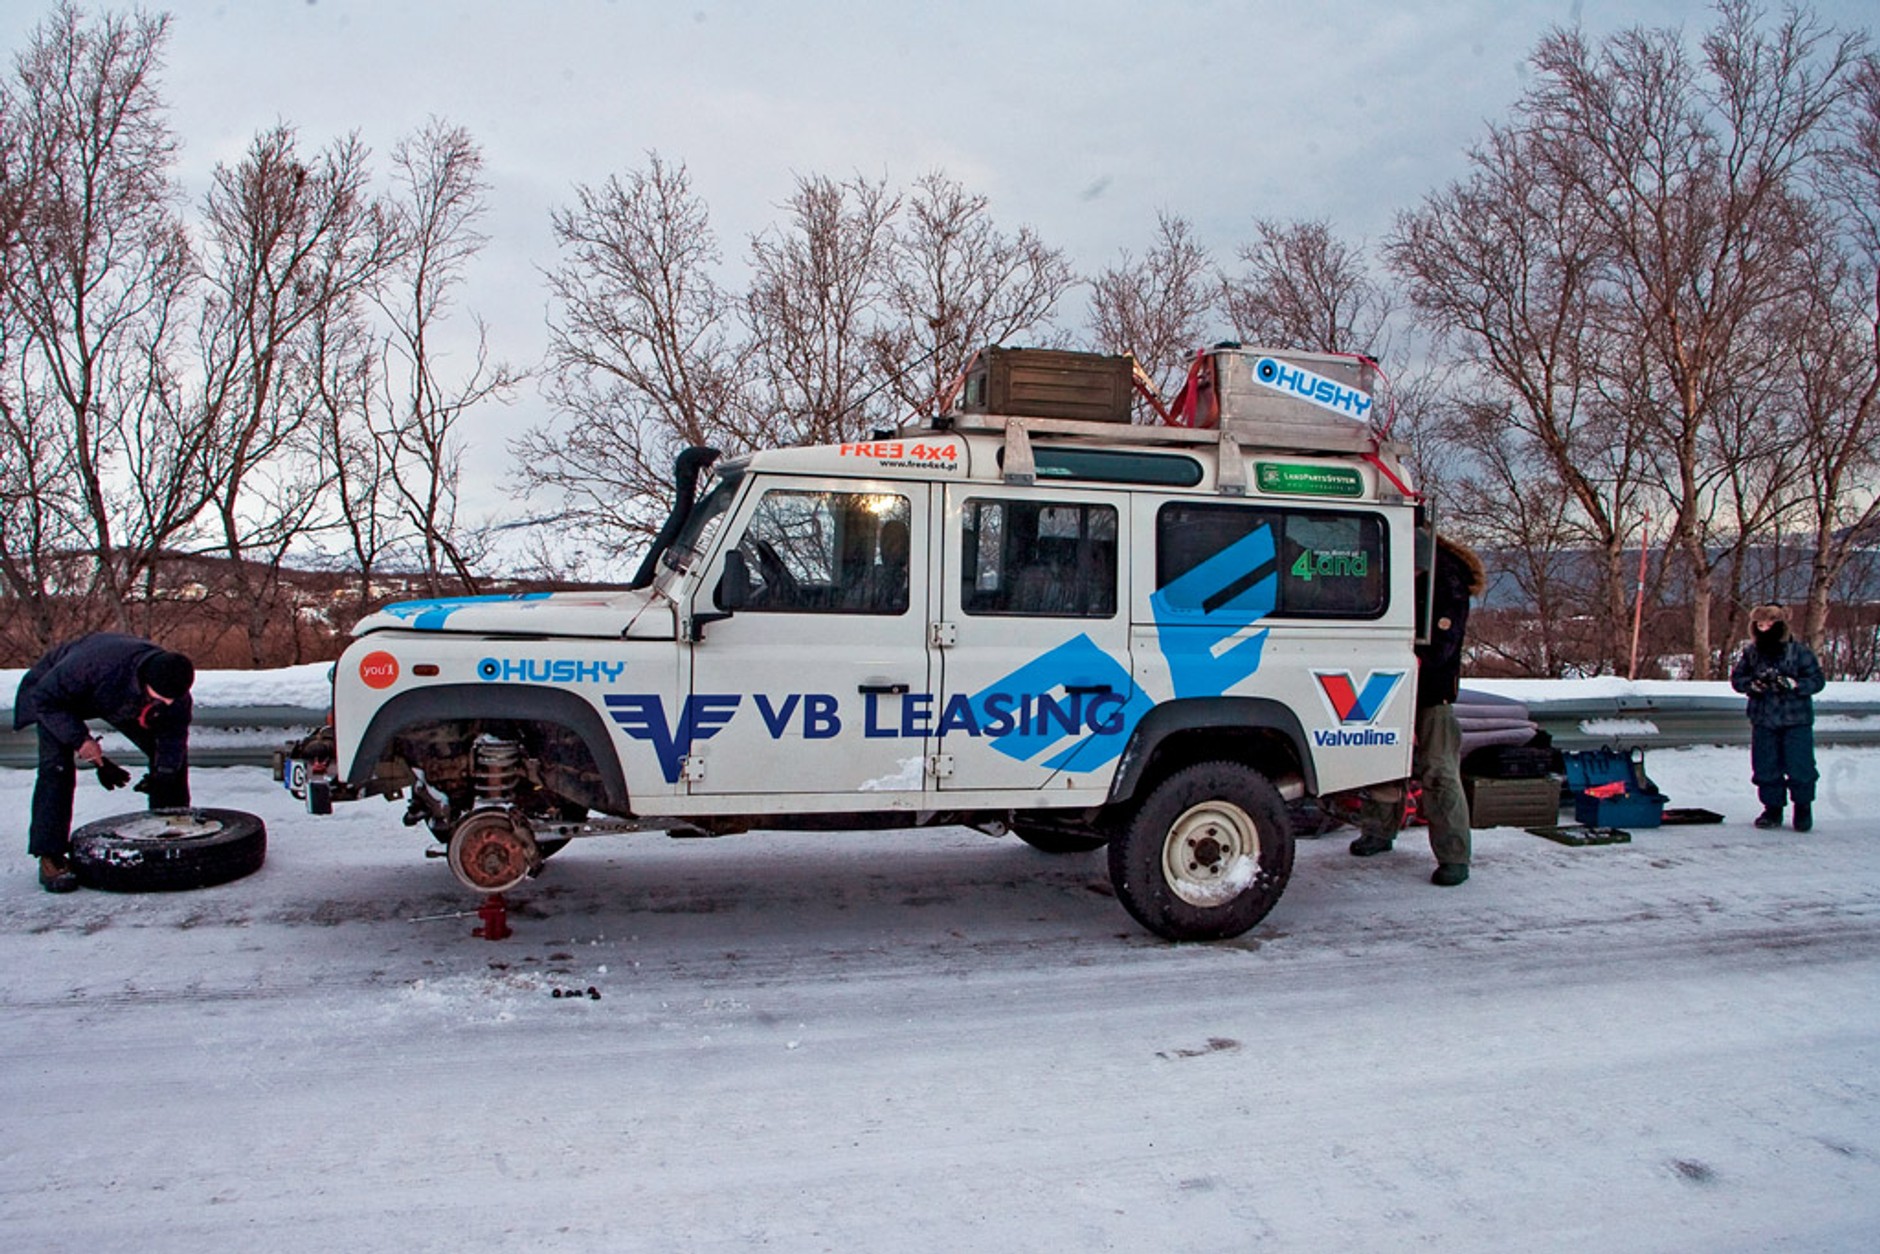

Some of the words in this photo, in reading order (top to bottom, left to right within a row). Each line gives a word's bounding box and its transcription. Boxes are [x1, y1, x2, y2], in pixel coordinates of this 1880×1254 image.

[910, 443, 958, 462] 4x4
[753, 693, 842, 740] VB
[864, 692, 1126, 740] LEASING
[1313, 729, 1397, 747] Valvoline
